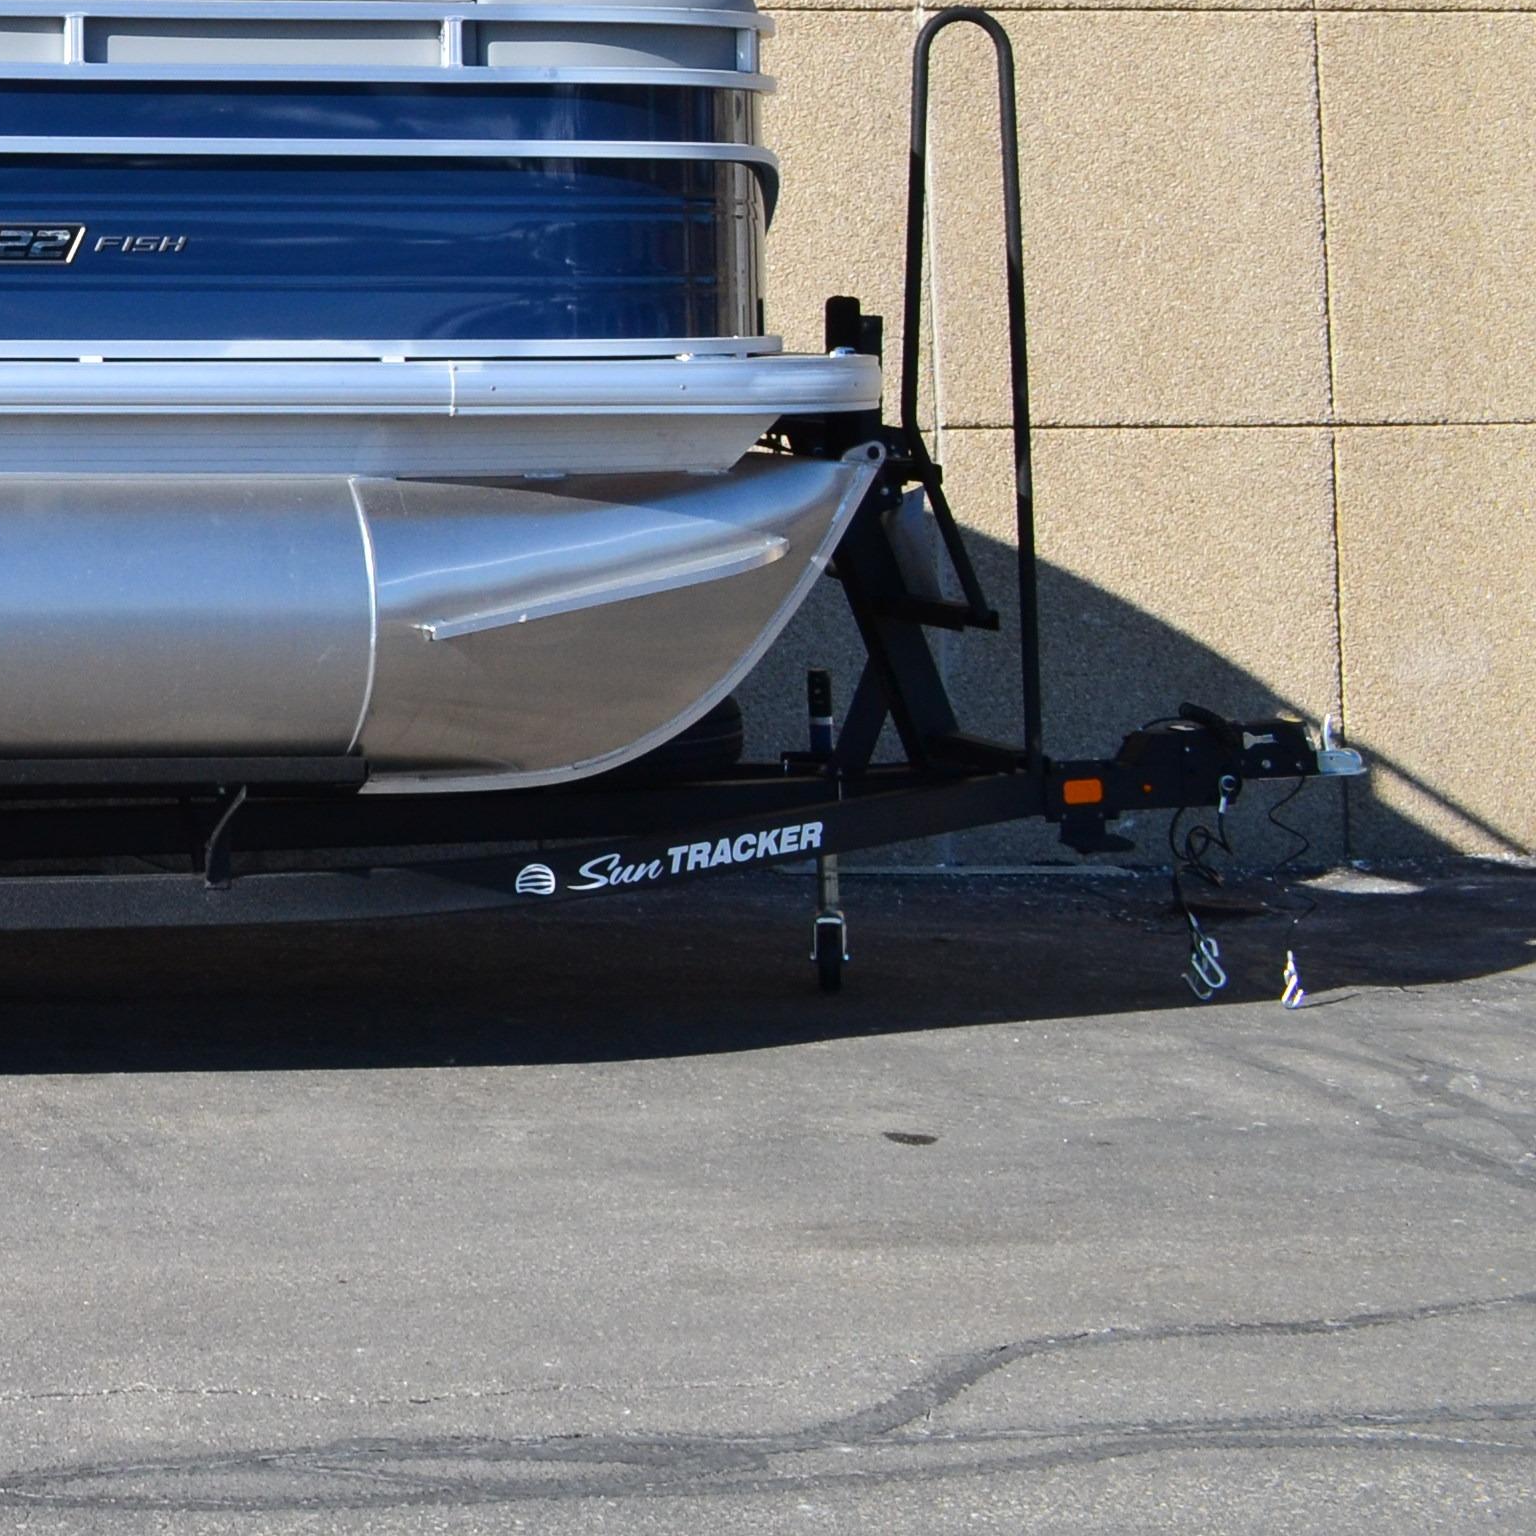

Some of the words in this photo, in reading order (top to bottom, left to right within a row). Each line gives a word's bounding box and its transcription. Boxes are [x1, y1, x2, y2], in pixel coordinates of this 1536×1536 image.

[93, 235, 188, 253] FISH
[566, 853, 664, 891] Sun
[667, 821, 824, 875] TRACKER
